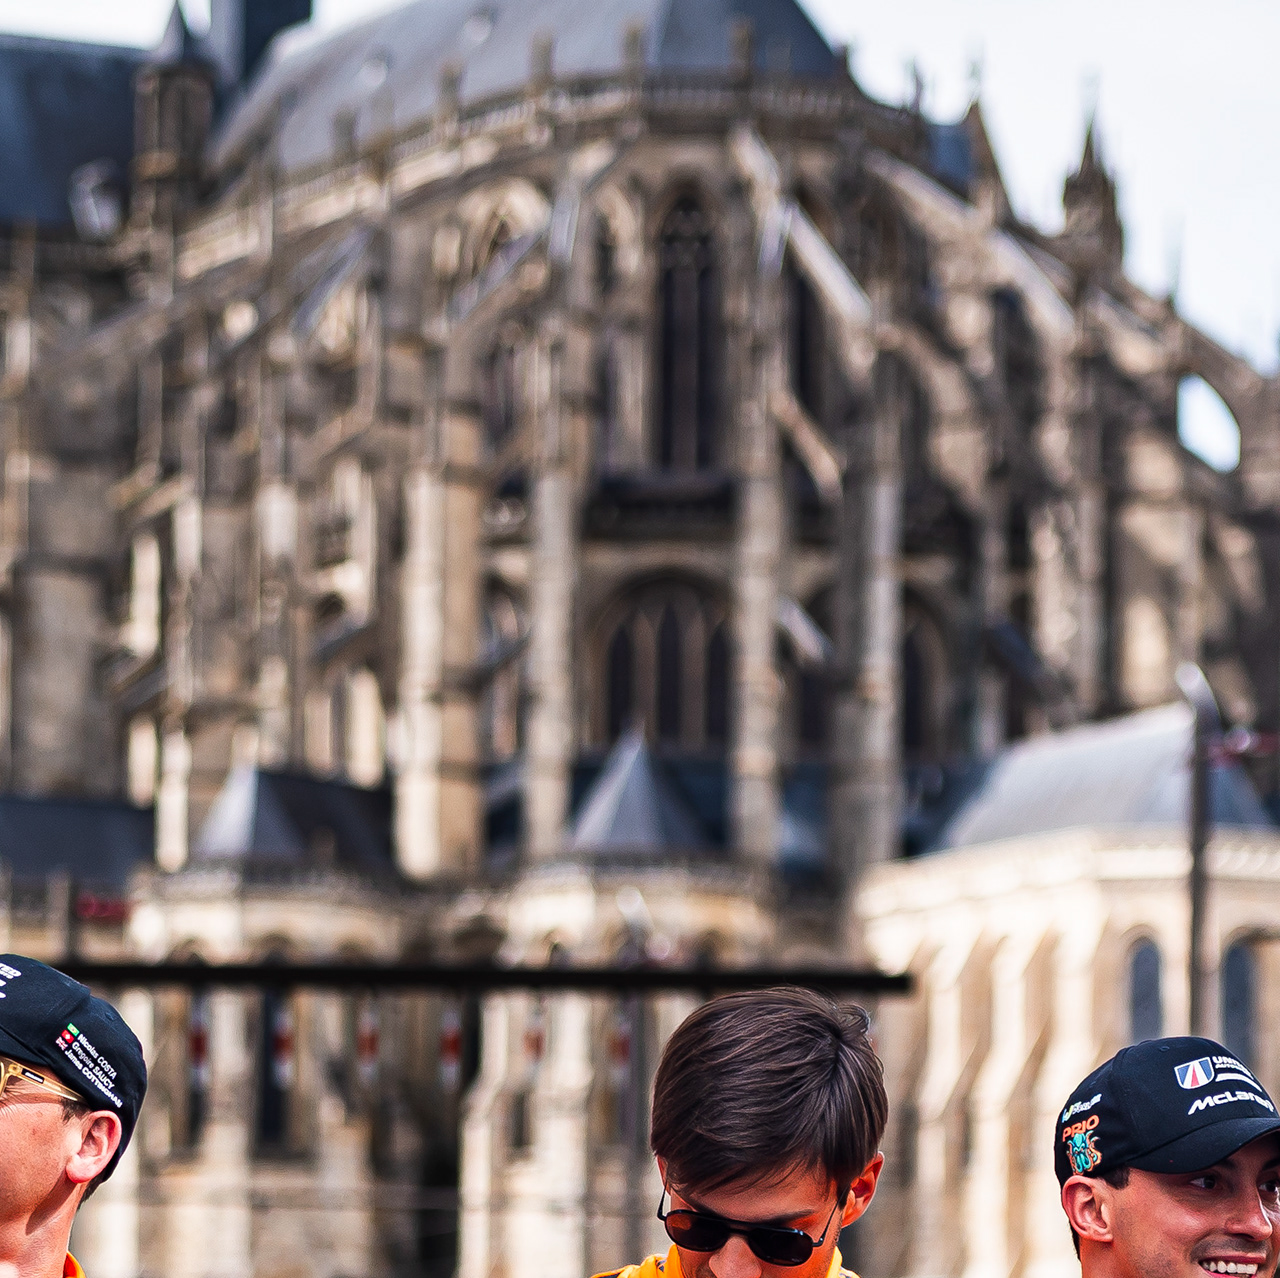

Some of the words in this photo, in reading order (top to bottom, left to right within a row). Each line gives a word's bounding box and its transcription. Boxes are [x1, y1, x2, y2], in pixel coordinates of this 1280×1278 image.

[77, 1033, 99, 1059] Nicolas
[97, 1056, 117, 1080] COSTA
[64, 1049, 83, 1070] James
[81, 1066, 123, 1108] COTTINGHAM
[92, 1066, 115, 1089] SAUCY
[1062, 1114, 1100, 1142] PRIO
